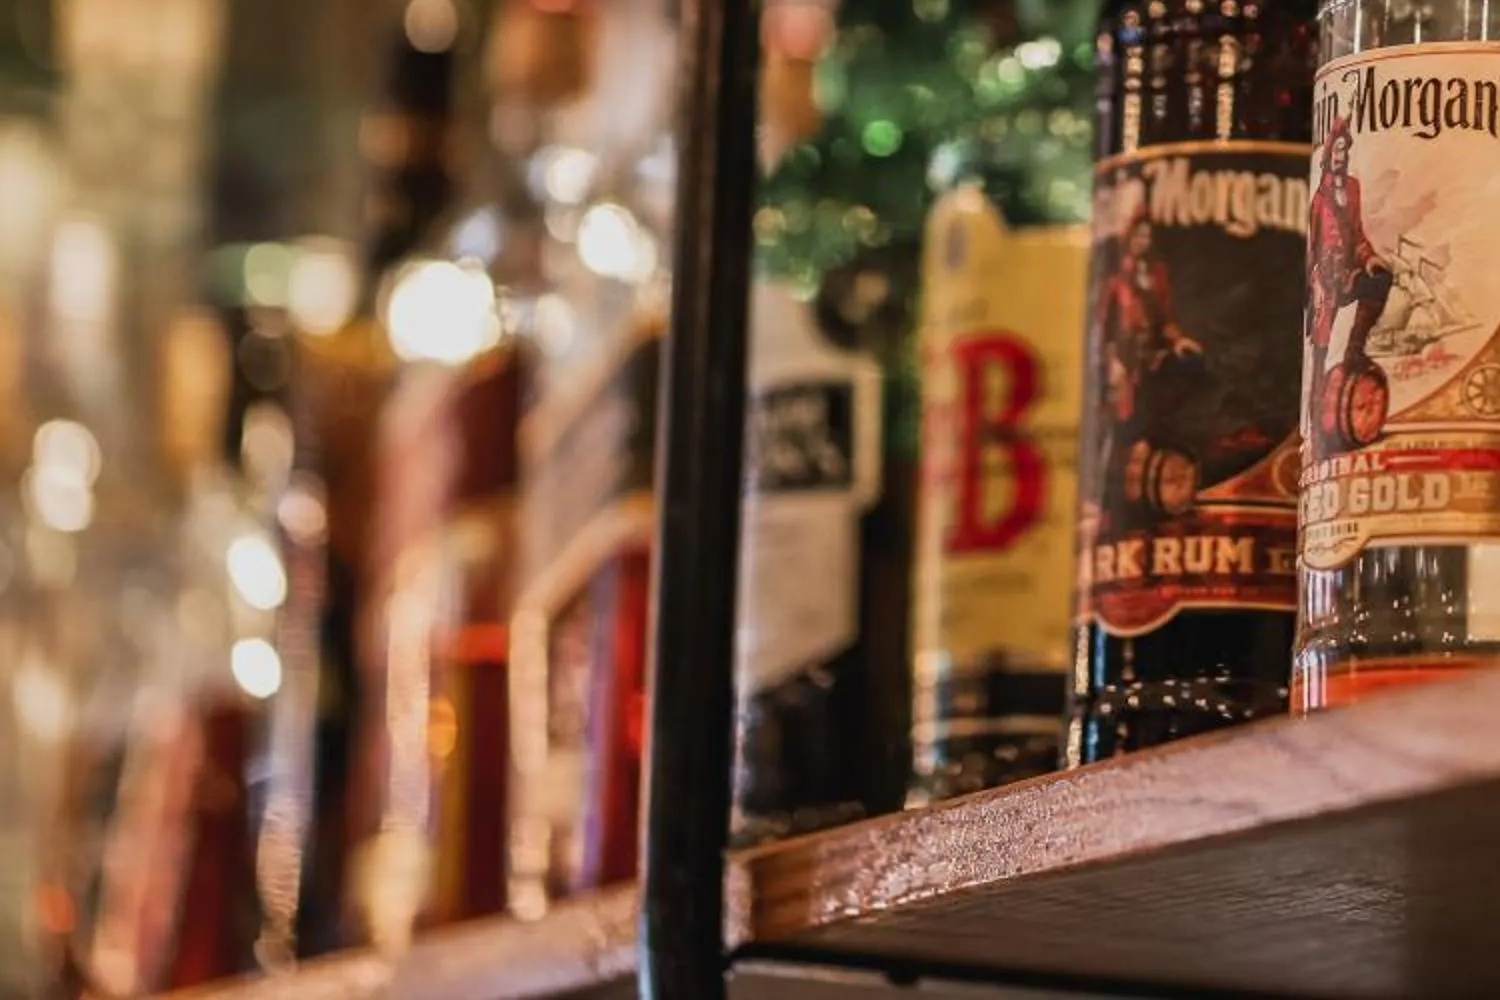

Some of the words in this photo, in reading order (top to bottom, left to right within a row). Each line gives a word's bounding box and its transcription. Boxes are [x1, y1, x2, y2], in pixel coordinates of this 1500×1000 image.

[1342, 66, 1499, 139] Morgan
[1142, 157, 1310, 238] Morgan
[1347, 472, 1450, 516] GOLD
[1152, 534, 1254, 575] RUM
